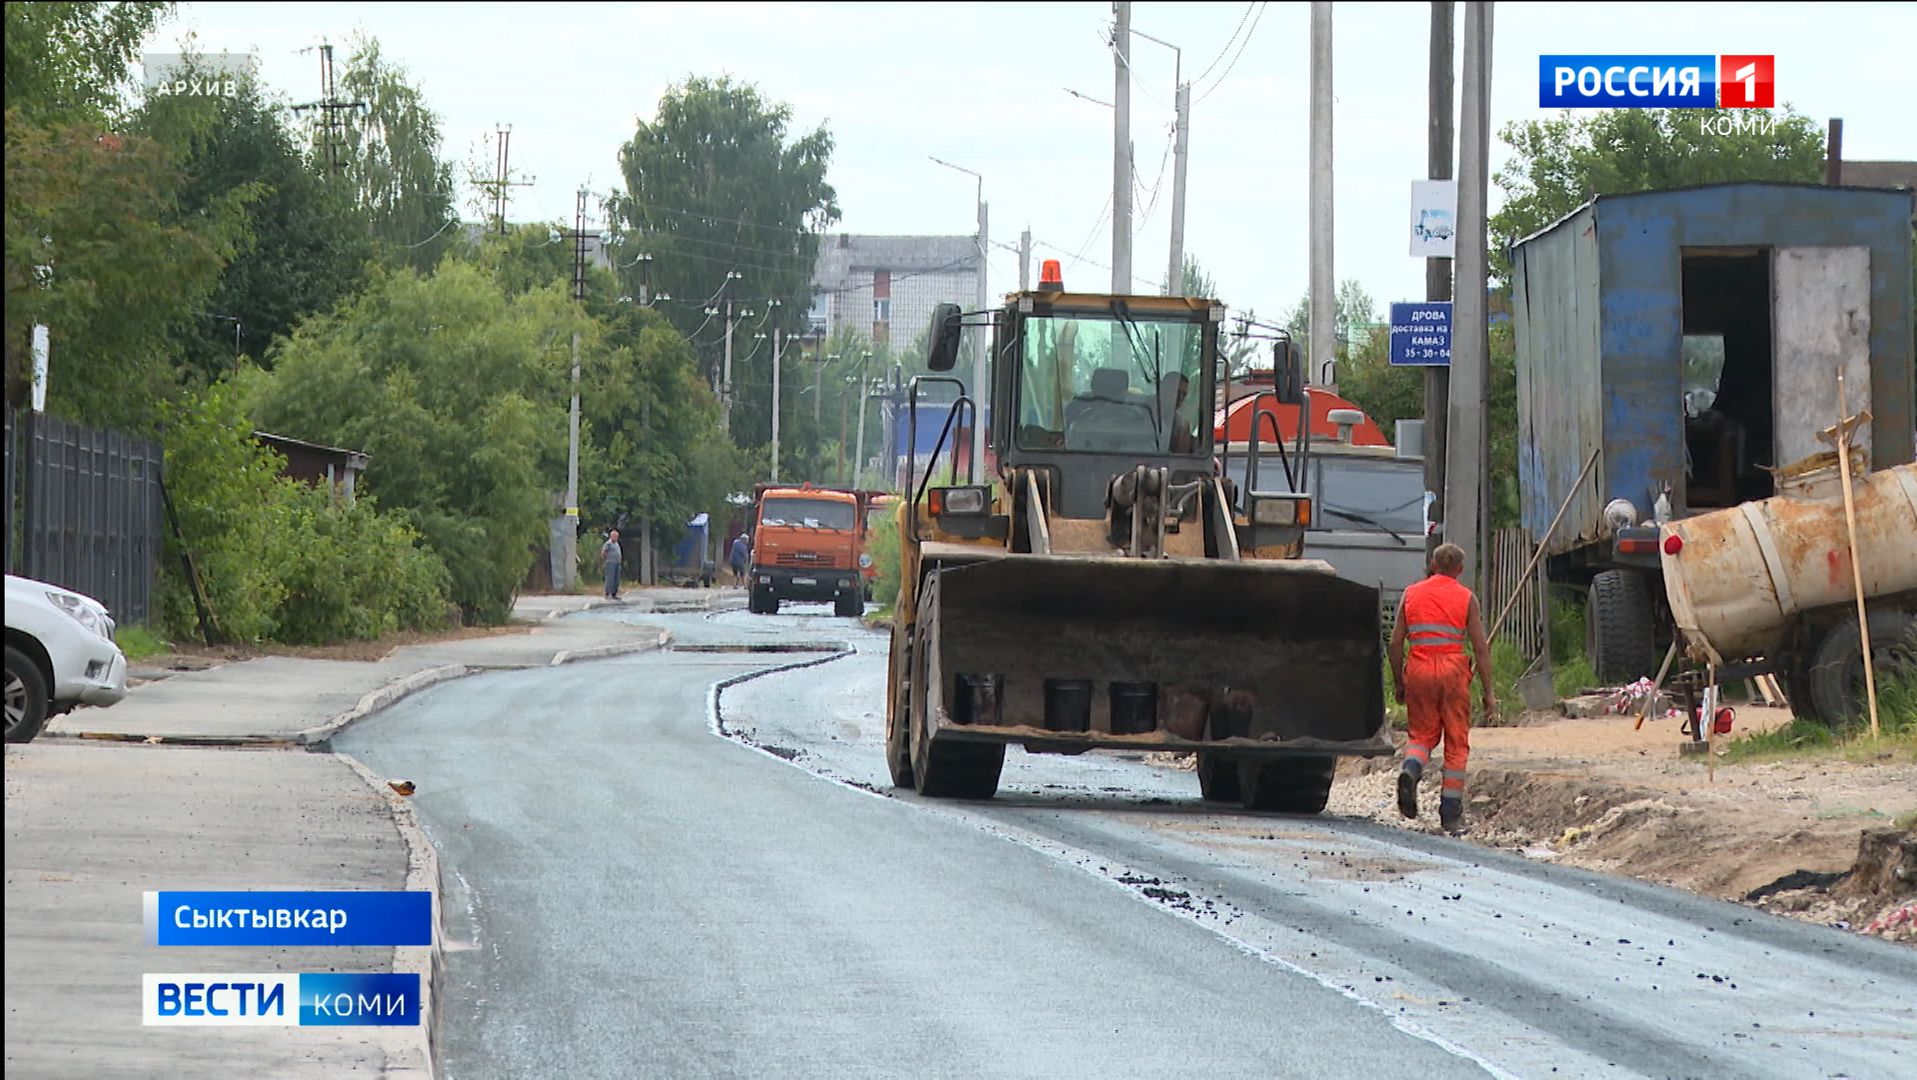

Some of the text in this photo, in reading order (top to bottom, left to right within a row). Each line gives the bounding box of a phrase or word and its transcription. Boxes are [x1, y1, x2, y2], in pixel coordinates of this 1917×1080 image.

[1411, 311, 1446, 322] ДРОВА
[1392, 325, 1448, 333] доставка на
[1411, 336, 1445, 346] КАМАЗ
